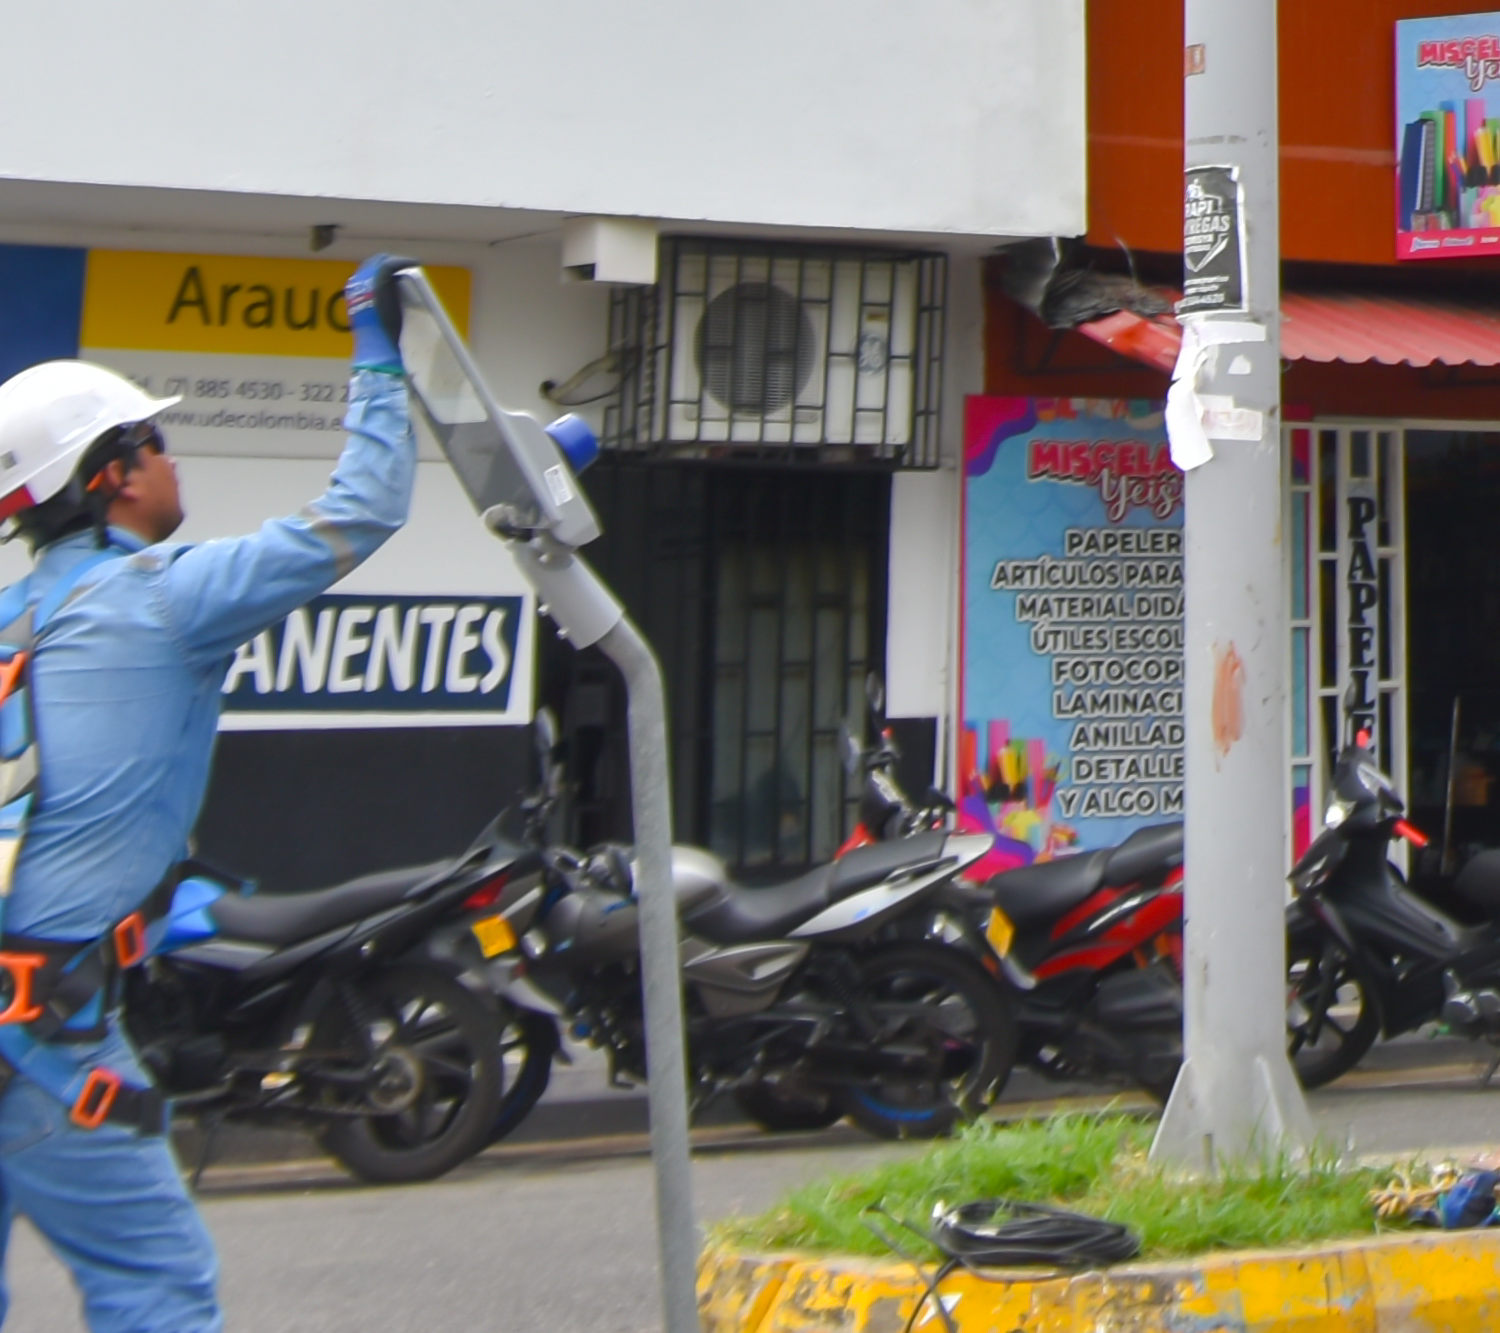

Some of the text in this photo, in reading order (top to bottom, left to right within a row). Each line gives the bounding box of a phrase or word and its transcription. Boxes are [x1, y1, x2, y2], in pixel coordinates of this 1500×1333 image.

[165, 265, 353, 333] Arauc
[194, 379, 230, 399] 885
[236, 380, 283, 401] 4530
[300, 382, 334, 403] 322
[1090, 468, 1185, 523] Yeis
[1065, 530, 1183, 557] PAPELER
[992, 557, 1120, 590] ARTÍCULOS
[1016, 594, 1133, 622] MATERIAL
[1030, 618, 1184, 654] ÚTILES ESCOL
[1052, 658, 1184, 686] FOTOCOPI
[1053, 690, 1184, 719] LAMINACI
[1070, 722, 1184, 751] ANILLAD
[1073, 755, 1184, 783] DETALLE
[1056, 788, 1184, 818] Y ALGO M
